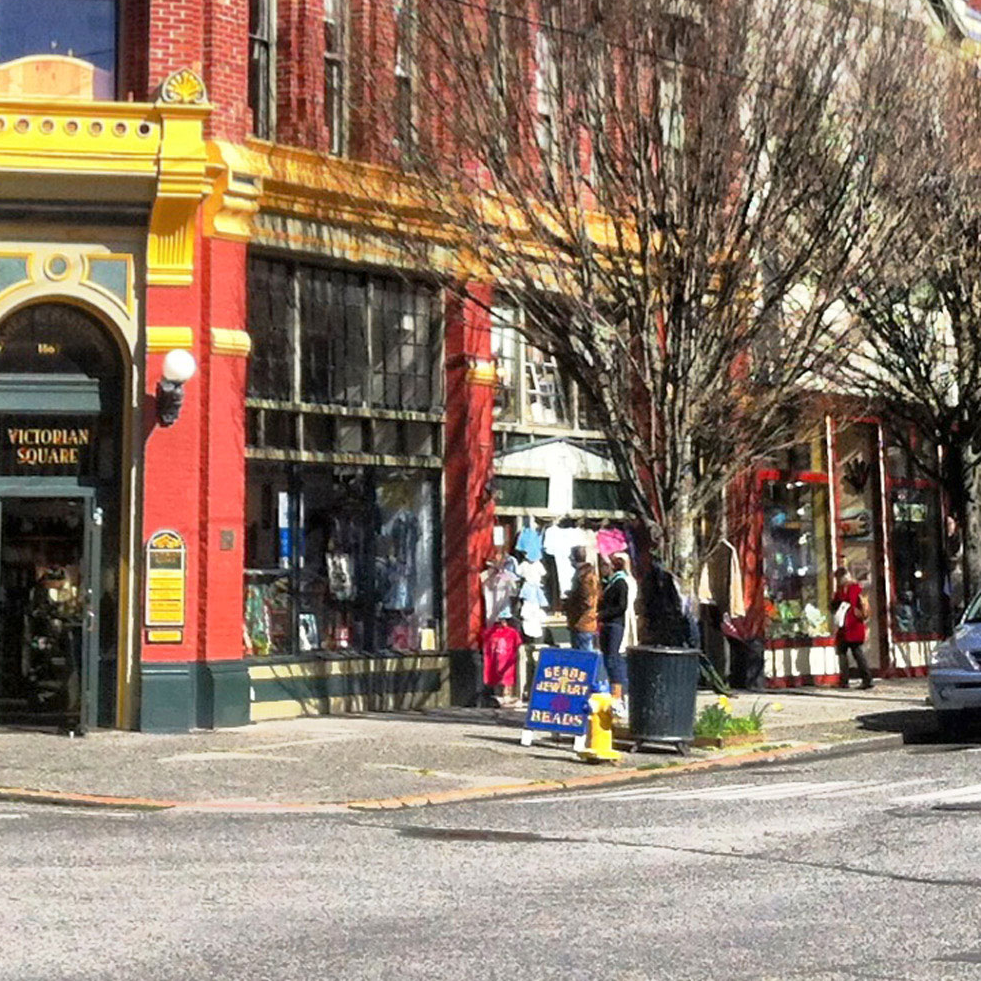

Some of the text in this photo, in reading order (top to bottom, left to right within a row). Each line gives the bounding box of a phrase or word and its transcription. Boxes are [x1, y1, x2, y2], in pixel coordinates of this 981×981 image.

[8, 428, 89, 445] VICTORIAN
[17, 448, 80, 465] SQUARE
[531, 709, 583, 728] BEADS
